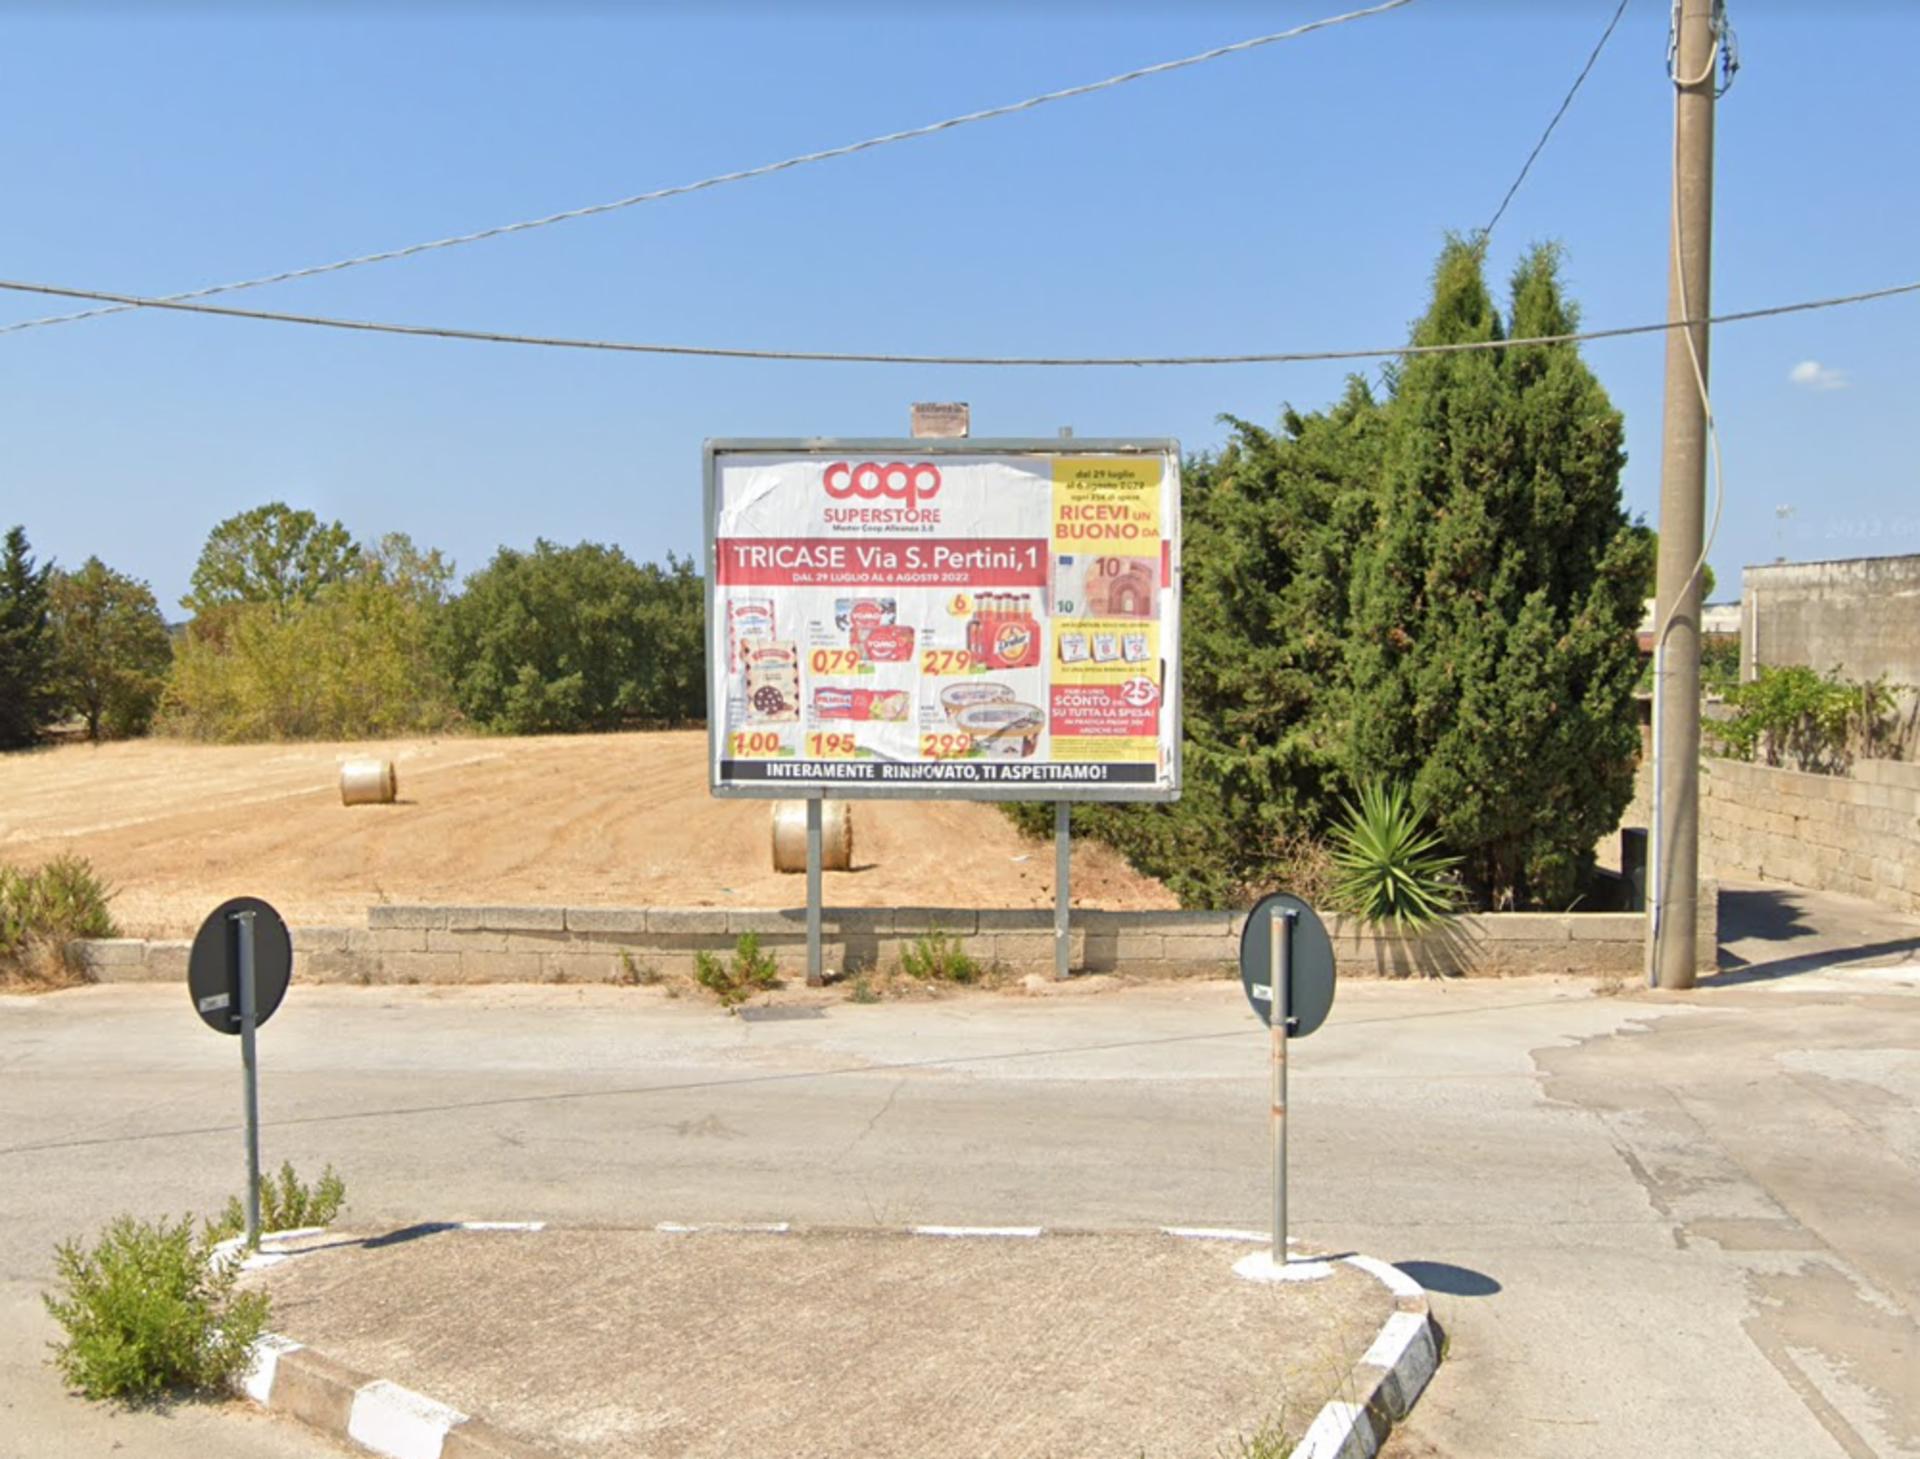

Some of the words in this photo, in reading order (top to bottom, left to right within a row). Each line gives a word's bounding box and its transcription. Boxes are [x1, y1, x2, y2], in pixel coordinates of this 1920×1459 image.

[1076, 470, 1091, 479] dal
[1093, 470, 1105, 479] 29
[1107, 470, 1135, 480] luglio
[823, 461, 942, 510] coop
[824, 508, 941, 523] SUPERSTORE
[1060, 504, 1129, 521] RICEVI
[1132, 511, 1151, 521] UN
[1055, 523, 1139, 540] BUONO
[1141, 528, 1159, 538] DA
[733, 545, 846, 568] TRICASE
[856, 545, 898, 568] Via
[905, 546, 929, 569] S.
[1095, 556, 1121, 577] 10
[792, 573, 812, 583] DAL
[816, 573, 828, 583] 29
[831, 573, 869, 583] LUGLIO
[871, 573, 884, 583] AL
[942, 573, 969, 583] 2022
[954, 593, 966, 610] 6
[1057, 600, 1074, 613] 10
[812, 649, 861, 675] 0,79
[923, 650, 971, 676] 2,79
[1054, 695, 1110, 707] SCONTO
[1069, 708, 1102, 718] TUTTA
[1103, 708, 1117, 718] LA
[734, 732, 780, 757] 1,00
[766, 762, 875, 779] INTERAMENTE
[983, 765, 997, 779] TI
[1001, 765, 1107, 780] ASPETTIAMO!
